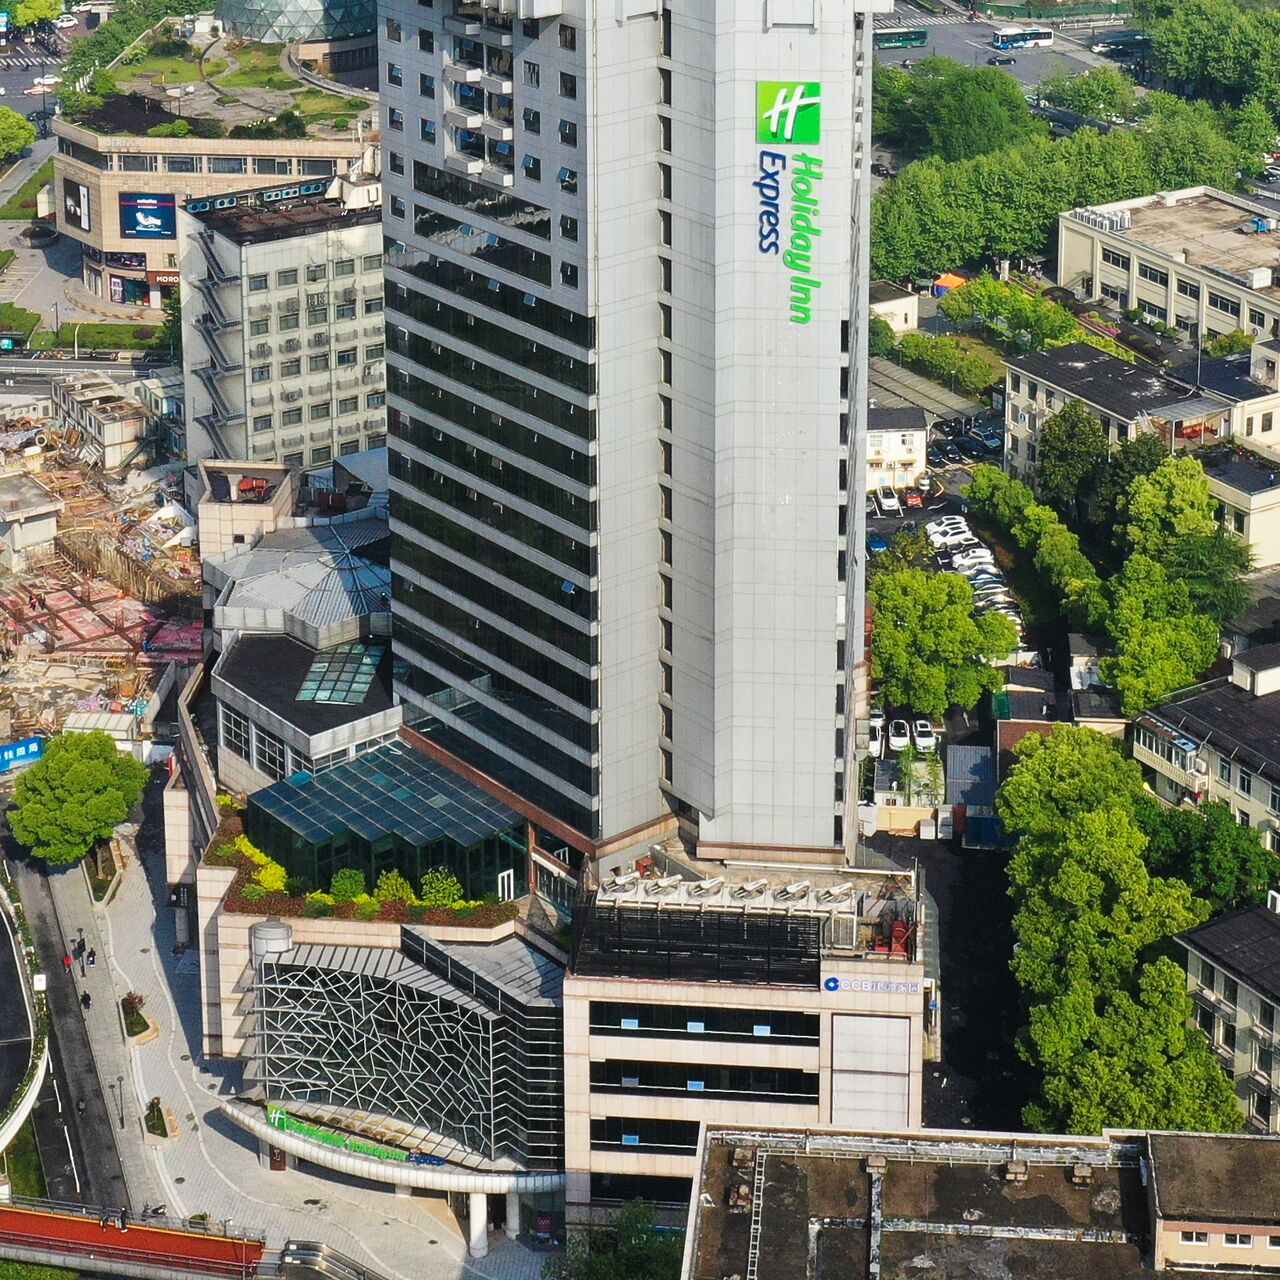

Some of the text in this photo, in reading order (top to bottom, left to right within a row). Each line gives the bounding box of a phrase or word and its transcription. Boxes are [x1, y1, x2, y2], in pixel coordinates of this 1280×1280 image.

[752, 150, 787, 255] Express
[783, 152, 824, 325] Holiday Inn
